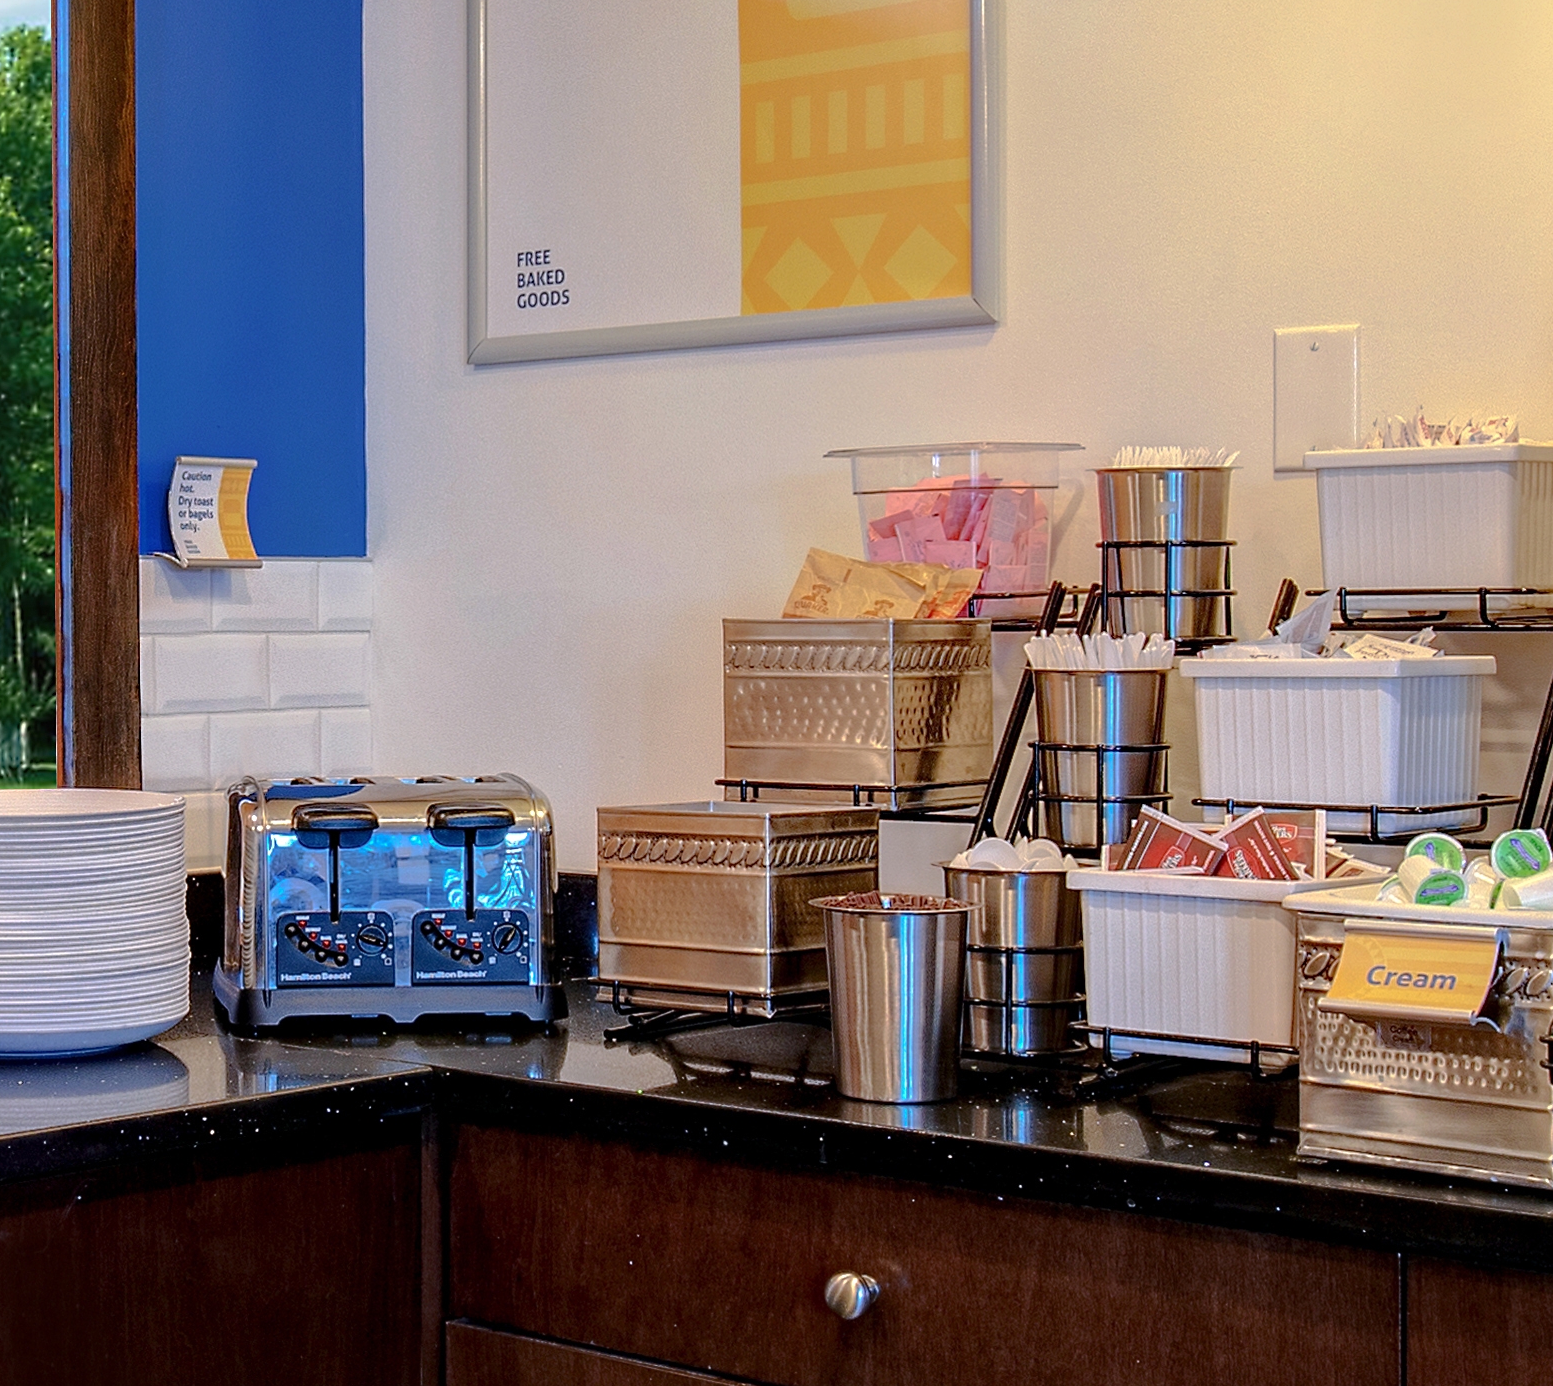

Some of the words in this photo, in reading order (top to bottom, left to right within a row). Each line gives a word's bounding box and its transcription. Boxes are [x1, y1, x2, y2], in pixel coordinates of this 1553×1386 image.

[517, 249, 551, 267] FREE
[517, 269, 565, 288] BAKED
[517, 289, 570, 309] GOODS
[182, 471, 212, 481] Caution
[178, 496, 192, 508] Dry
[194, 498, 213, 506] toast
[178, 510, 186, 518] or
[188, 510, 213, 521] bagels
[1366, 965, 1457, 991] Cream
